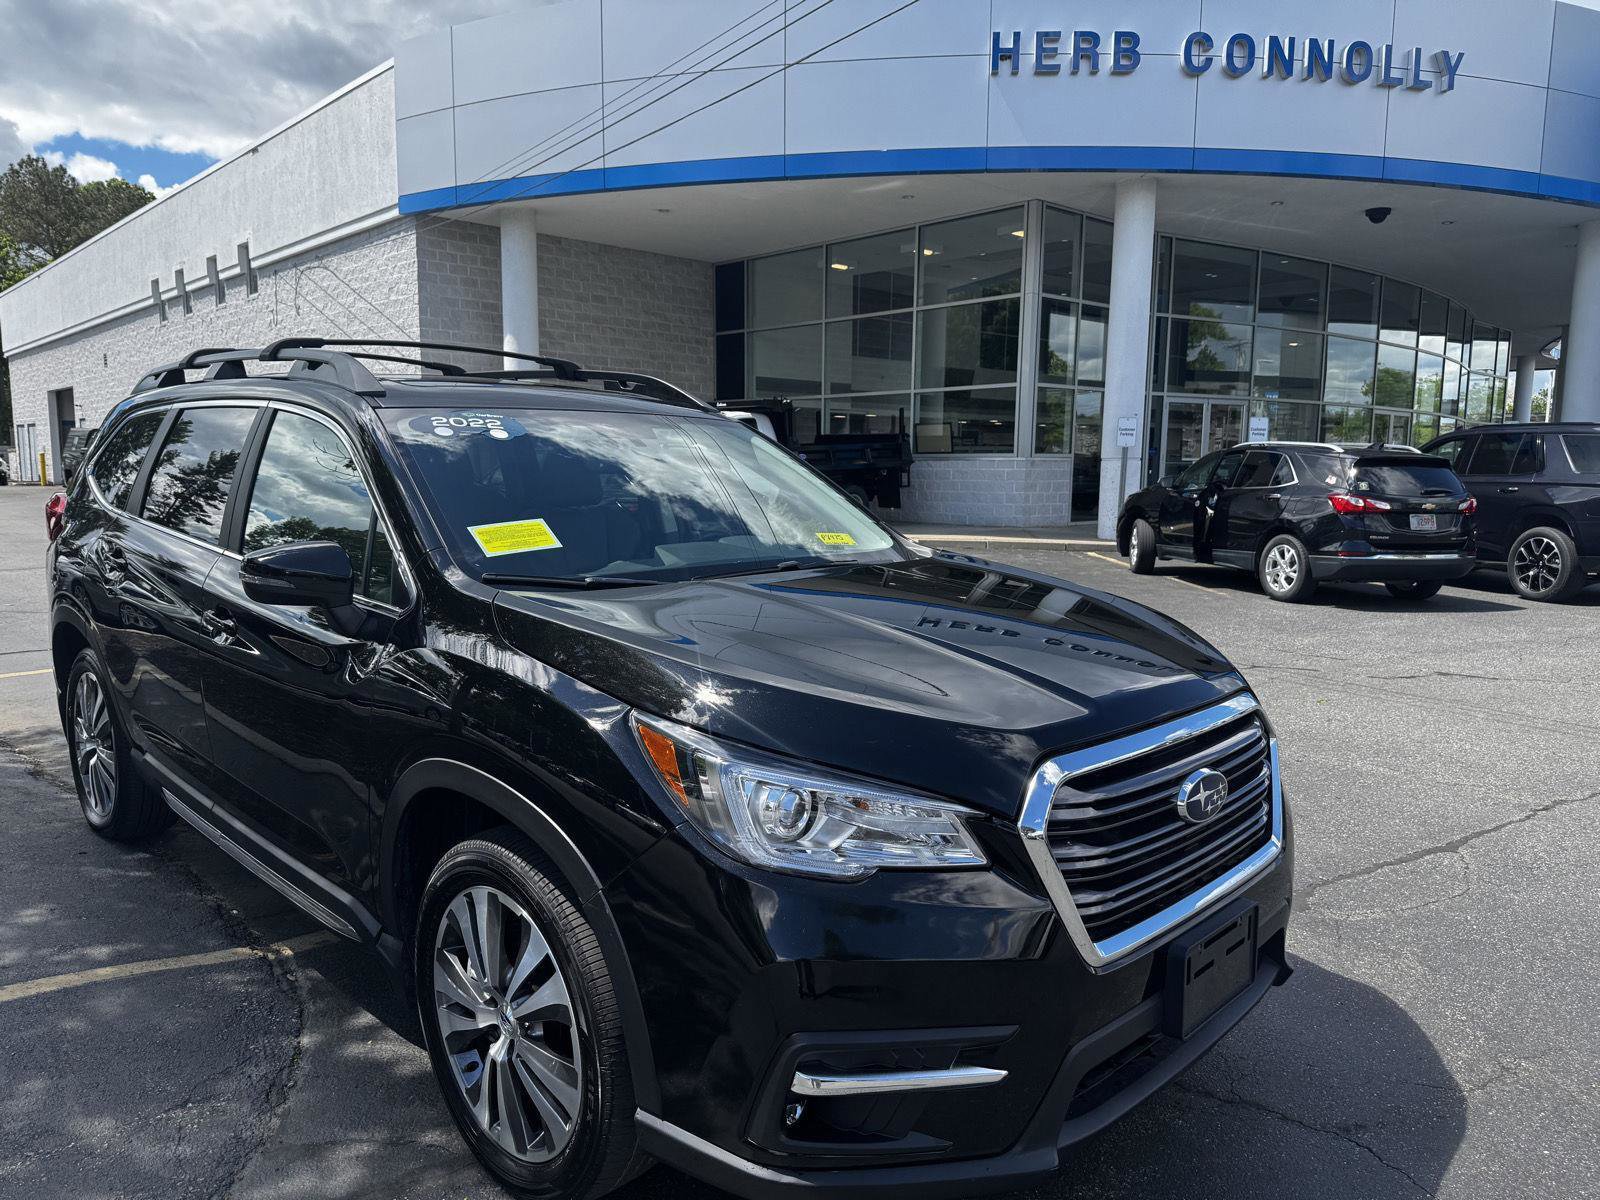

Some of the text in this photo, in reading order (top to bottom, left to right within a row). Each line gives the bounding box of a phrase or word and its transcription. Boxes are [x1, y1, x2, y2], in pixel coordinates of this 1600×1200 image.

[991, 31, 1465, 94] HERB CONNOLLY
[430, 416, 504, 429] 2022
